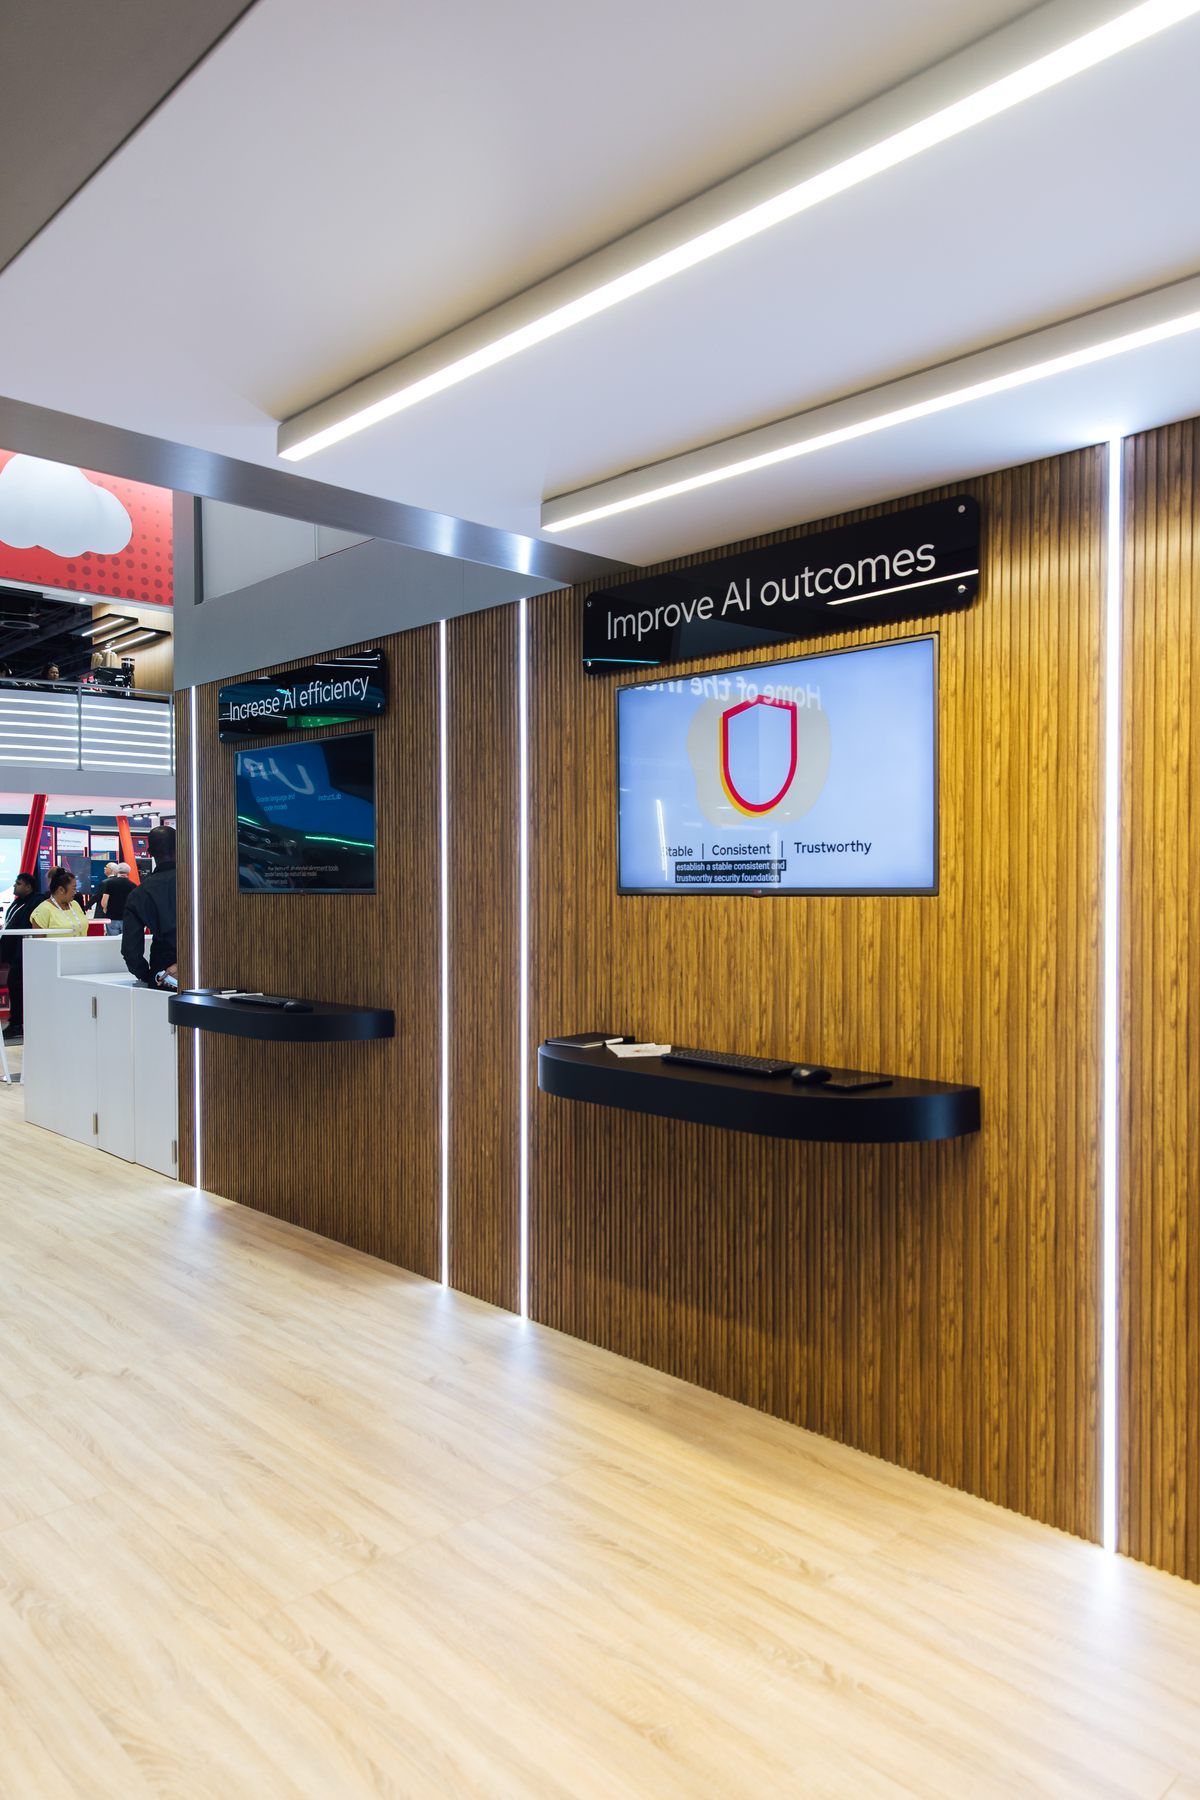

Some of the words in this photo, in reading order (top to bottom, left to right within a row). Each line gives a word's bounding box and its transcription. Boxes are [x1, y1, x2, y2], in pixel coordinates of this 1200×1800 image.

[607, 596, 714, 642] Improve
[721, 578, 752, 616] AI
[760, 543, 936, 605] outcomes
[229, 697, 280, 722] Increase
[282, 688, 296, 711] AI
[299, 676, 370, 708] efficiency
[712, 843, 771, 856] Consistent
[794, 840, 872, 855] Trustworthy
[676, 861, 706, 871] establish
[711, 861, 732, 871] stable
[733, 861, 770, 871] consistent
[771, 861, 785, 870] and
[676, 873, 712, 884] trustworthy
[714, 873, 740, 883] security
[741, 872, 780, 882] foundation
